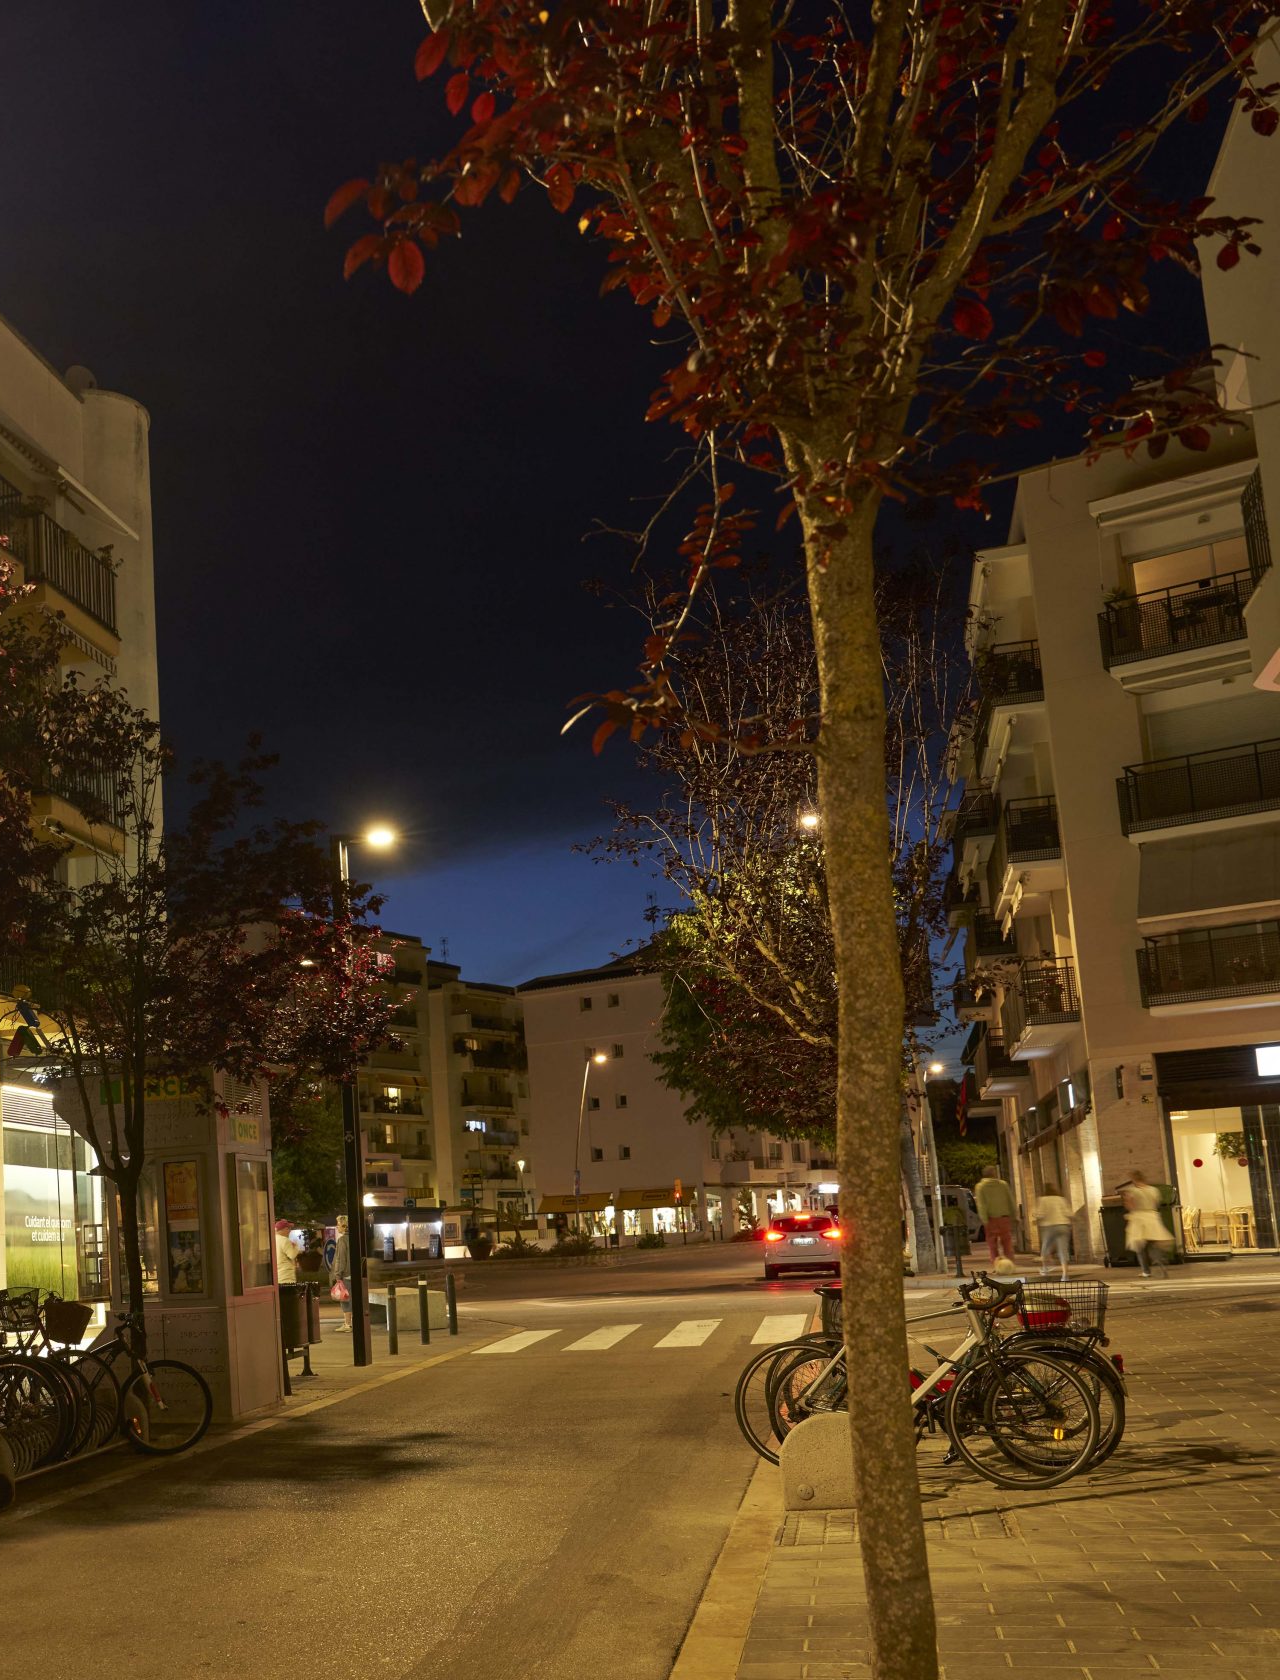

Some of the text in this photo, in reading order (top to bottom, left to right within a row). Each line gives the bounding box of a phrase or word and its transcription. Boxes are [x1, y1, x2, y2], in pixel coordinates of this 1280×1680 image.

[238, 1122, 258, 1140] ONCE
[25, 1216, 45, 1228] Cuidant
[46, 1216, 51, 1228] el
[32, 1231, 38, 1241] et
